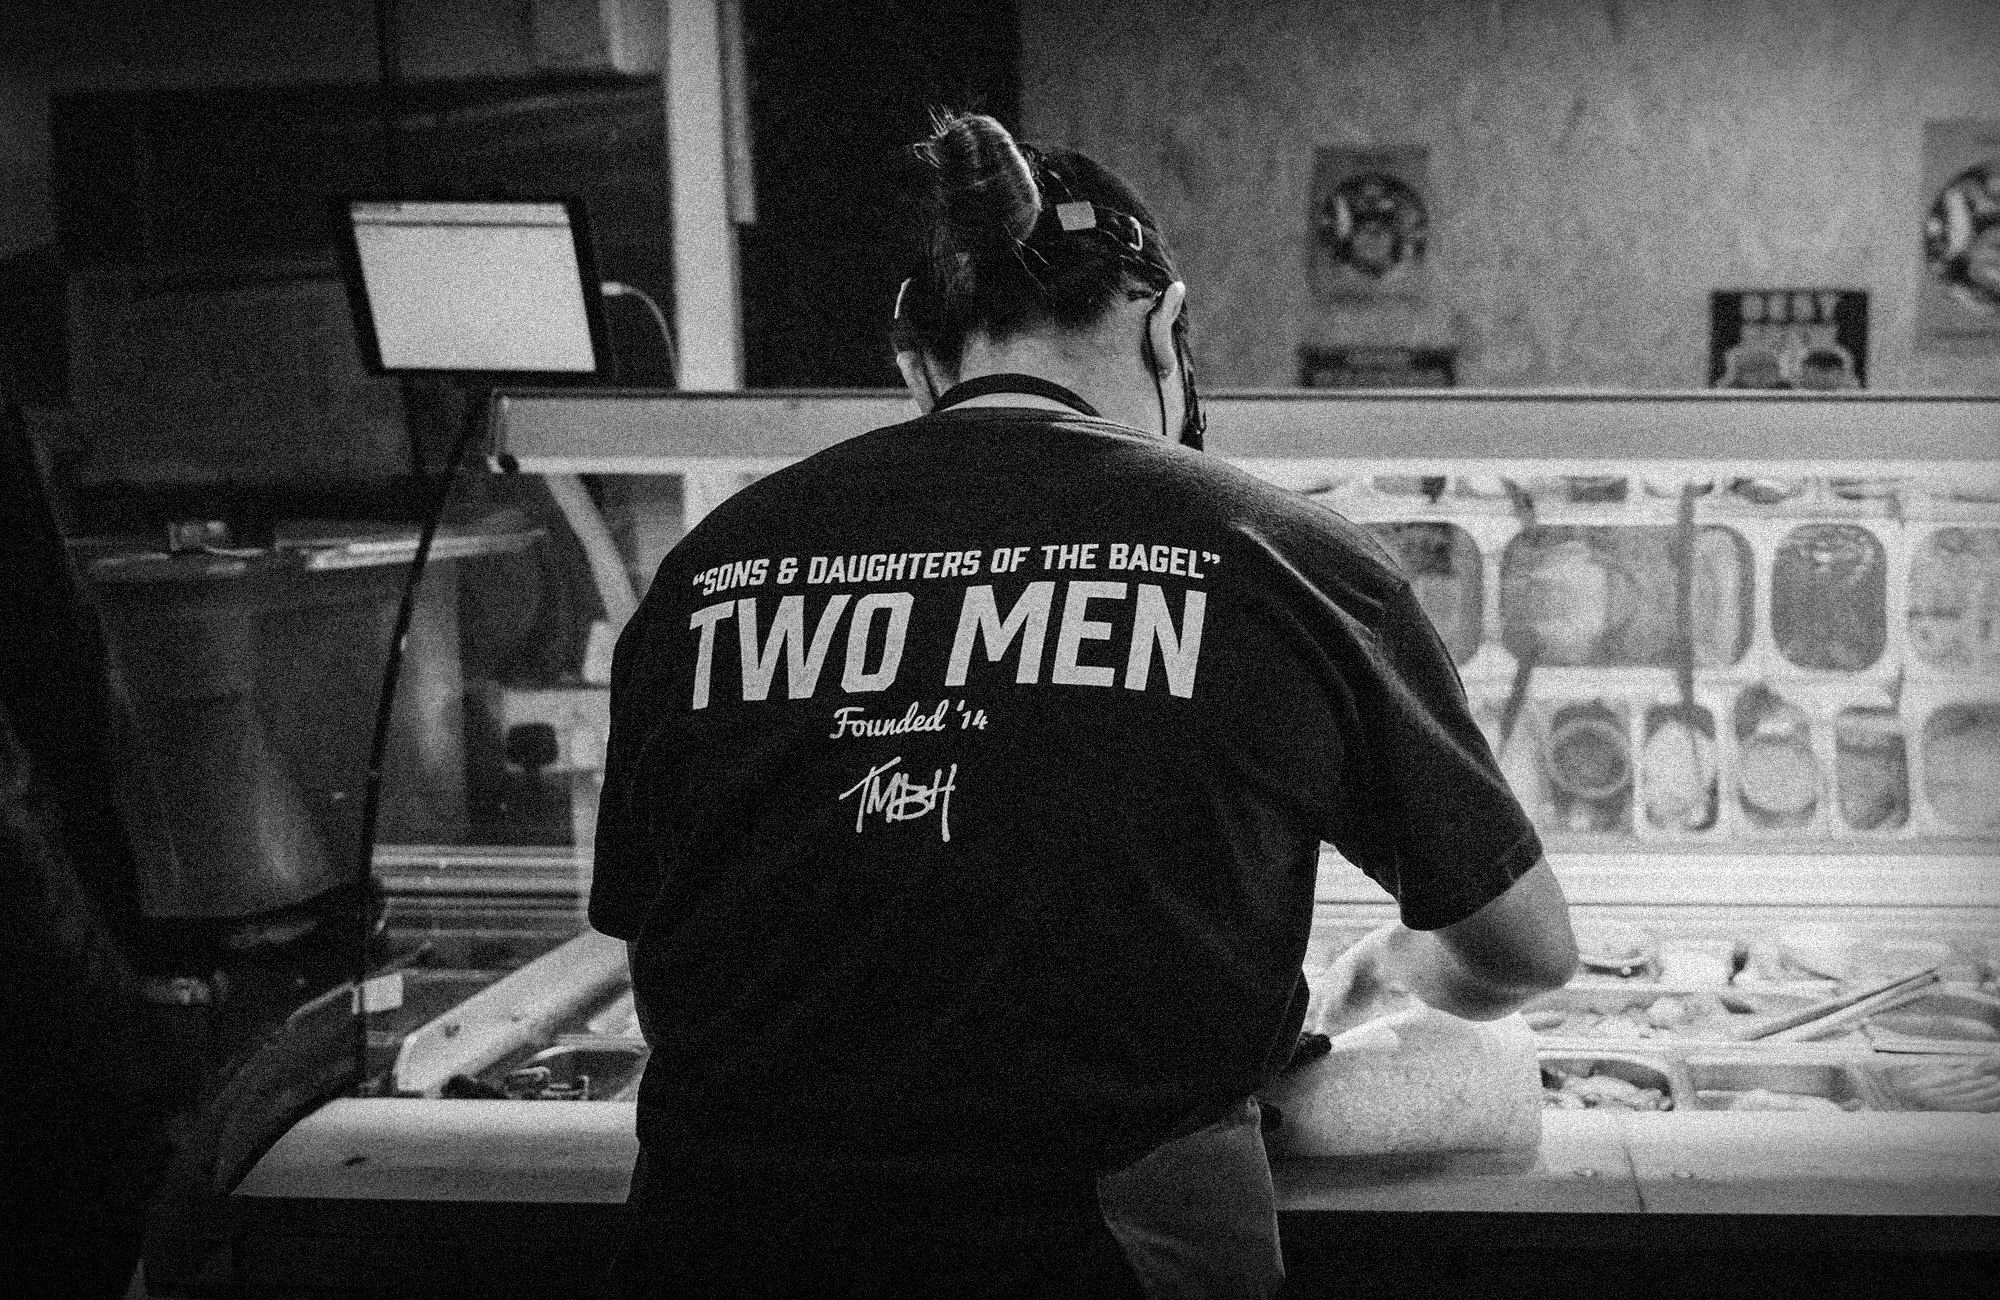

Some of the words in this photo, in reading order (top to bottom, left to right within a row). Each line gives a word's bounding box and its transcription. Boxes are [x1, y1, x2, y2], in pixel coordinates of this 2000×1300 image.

[777, 556, 799, 585] &
[806, 550, 983, 585] DAUGHTERS
[990, 546, 1031, 574] OF
[1040, 543, 1100, 573] THE
[689, 590, 915, 710] TWO
[941, 580, 1207, 699] MEN
[829, 699, 948, 738] Founded
[838, 756, 958, 843] TMBH
